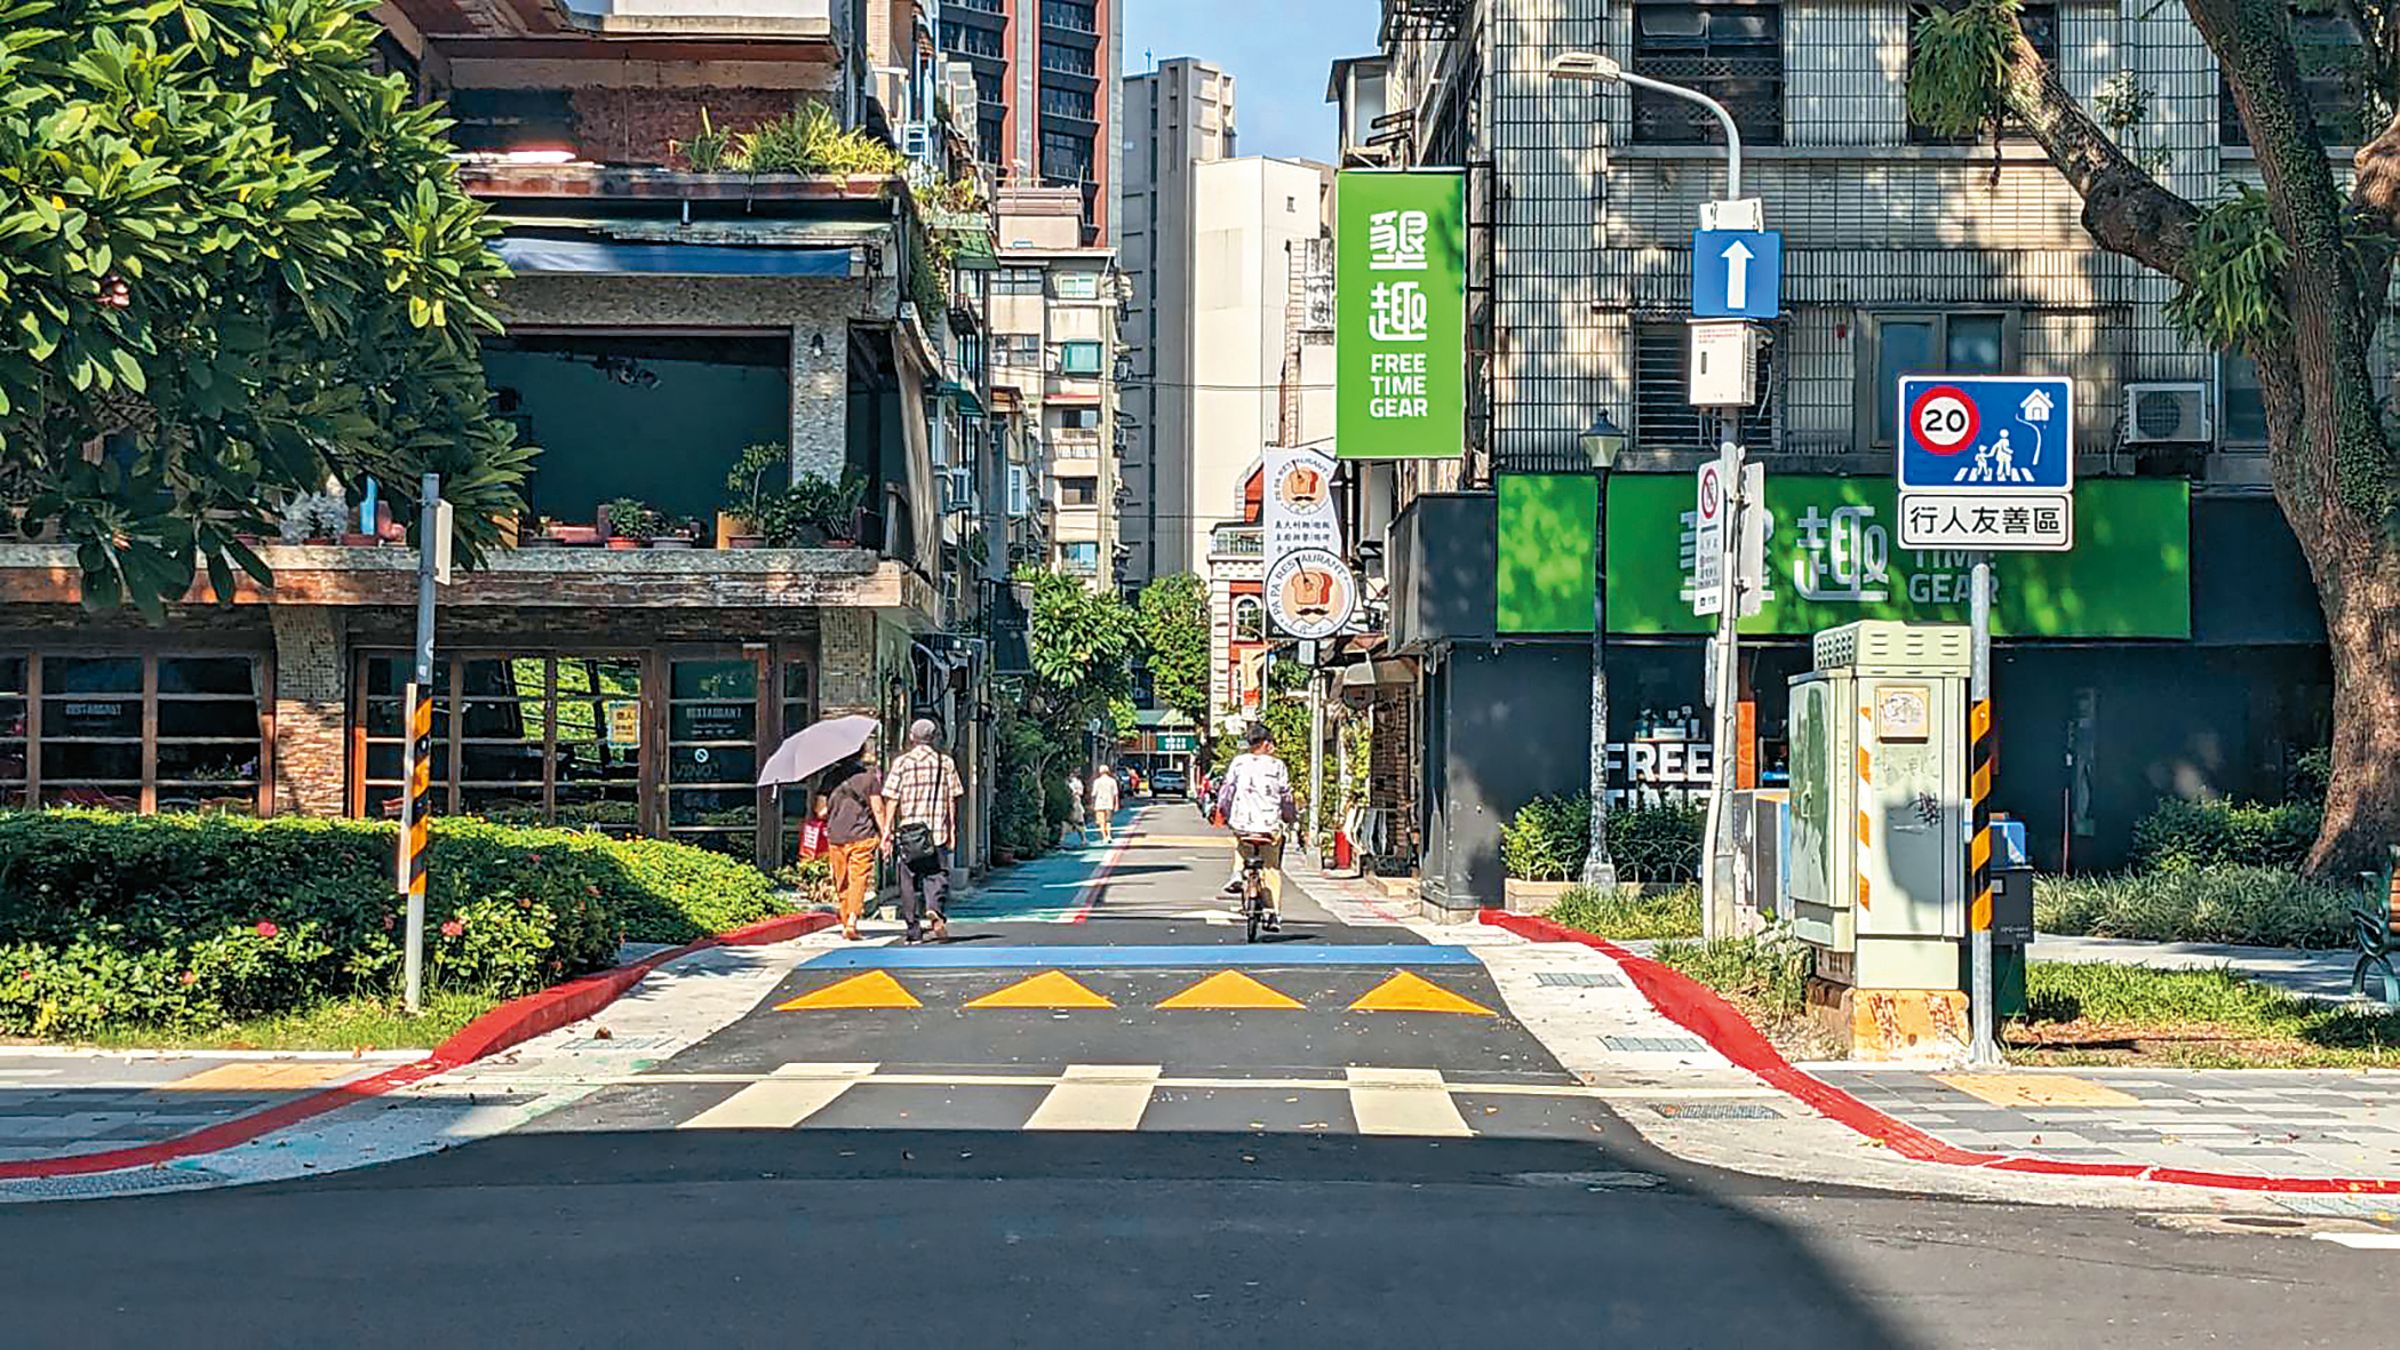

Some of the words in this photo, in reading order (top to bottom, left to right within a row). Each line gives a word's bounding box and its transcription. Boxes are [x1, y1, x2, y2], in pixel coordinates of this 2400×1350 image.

[1371, 353, 1427, 373] FREE
[1371, 376, 1427, 395] TIME
[1369, 398, 1428, 418] GEAR
[1925, 409, 1966, 432] 20
[1910, 506, 2061, 534] 行人友善區
[1275, 553, 1347, 580] RESAURANT
[1270, 583, 1280, 598] PA
[1271, 600, 1282, 616] PA
[1605, 743, 1714, 782] FREE
